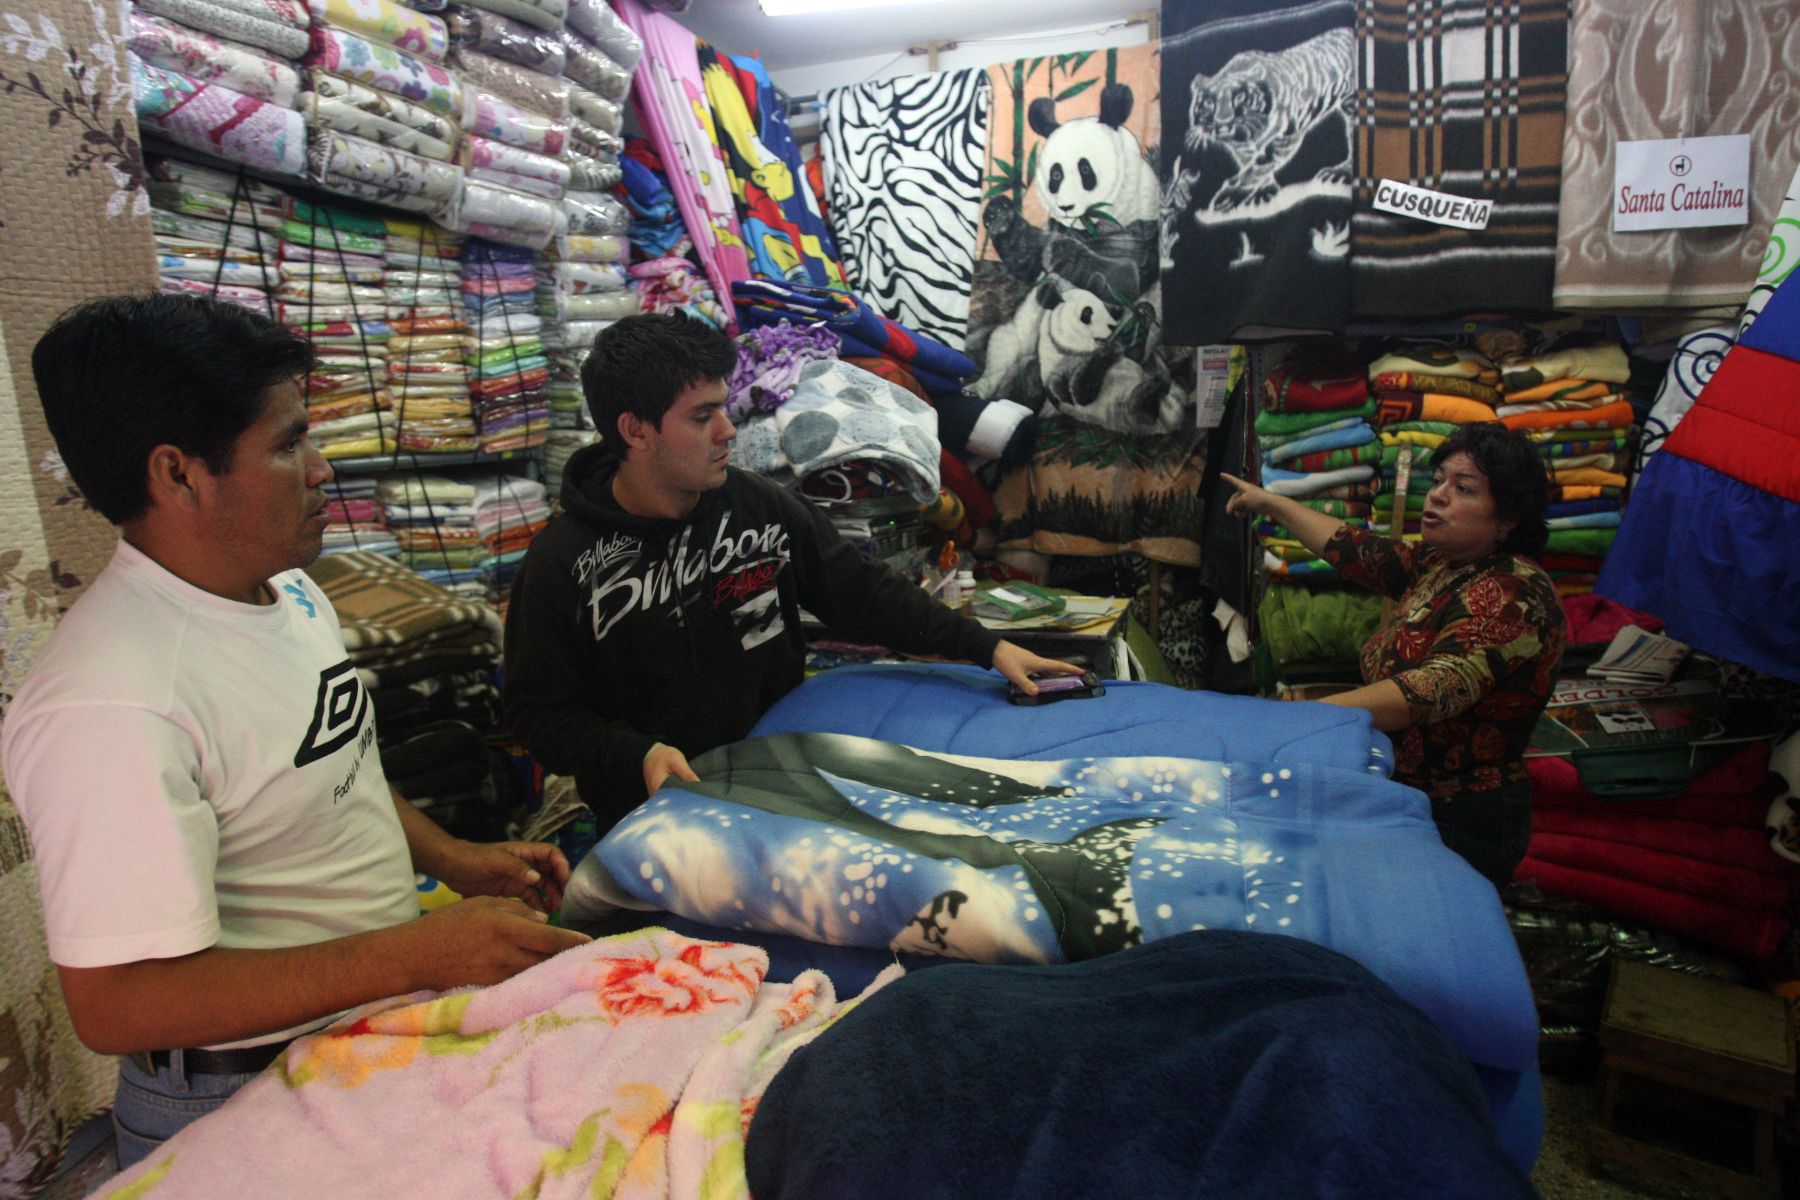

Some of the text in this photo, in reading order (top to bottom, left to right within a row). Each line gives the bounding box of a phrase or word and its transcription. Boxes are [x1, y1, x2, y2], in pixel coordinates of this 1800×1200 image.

[1378, 186, 1489, 223] CUSQUEÑA
[1618, 180, 1744, 214] Santa Catalina
